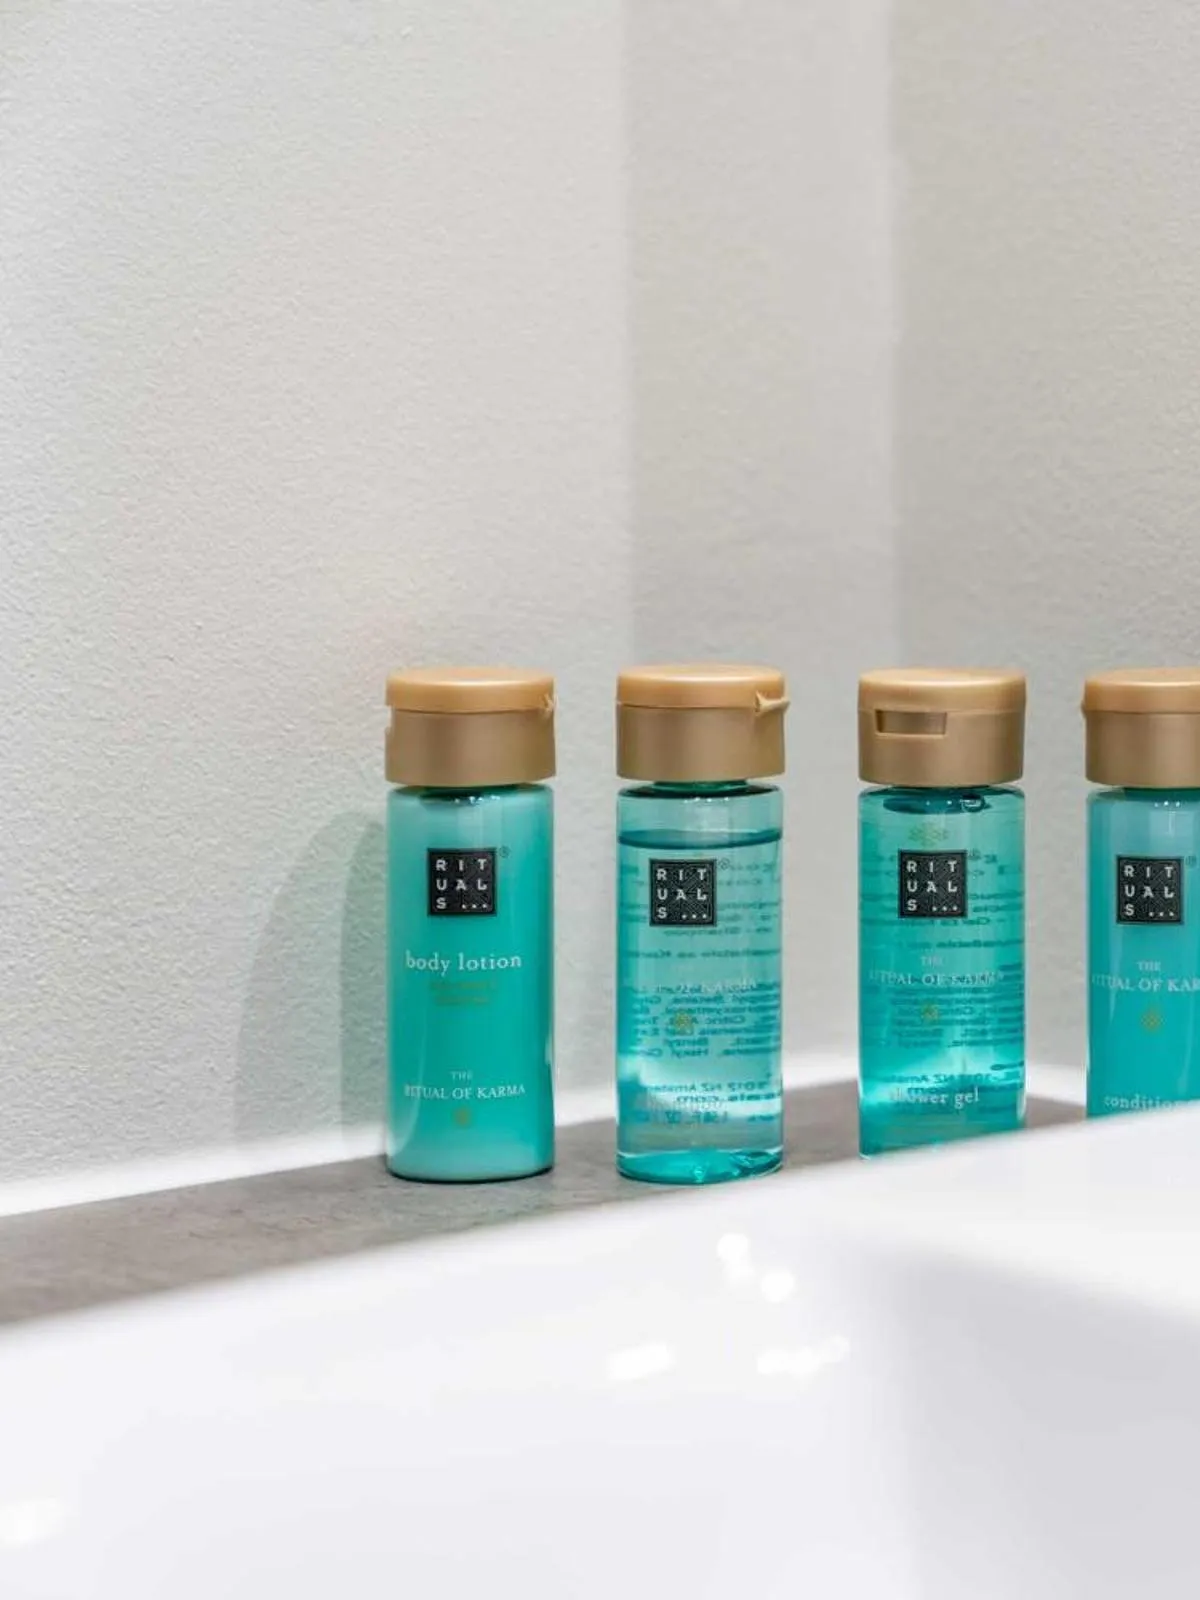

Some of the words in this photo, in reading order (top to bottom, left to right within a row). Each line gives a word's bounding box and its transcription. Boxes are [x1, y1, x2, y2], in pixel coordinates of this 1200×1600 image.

[405, 949, 450, 977] body
[458, 952, 522, 970] lotion
[1137, 961, 1161, 972] THE
[1138, 978, 1162, 992] OF
[450, 1071, 473, 1081] THE
[452, 1087, 473, 1100] OF
[477, 1084, 526, 1099] KARMA
[954, 1085, 979, 1109] gel
